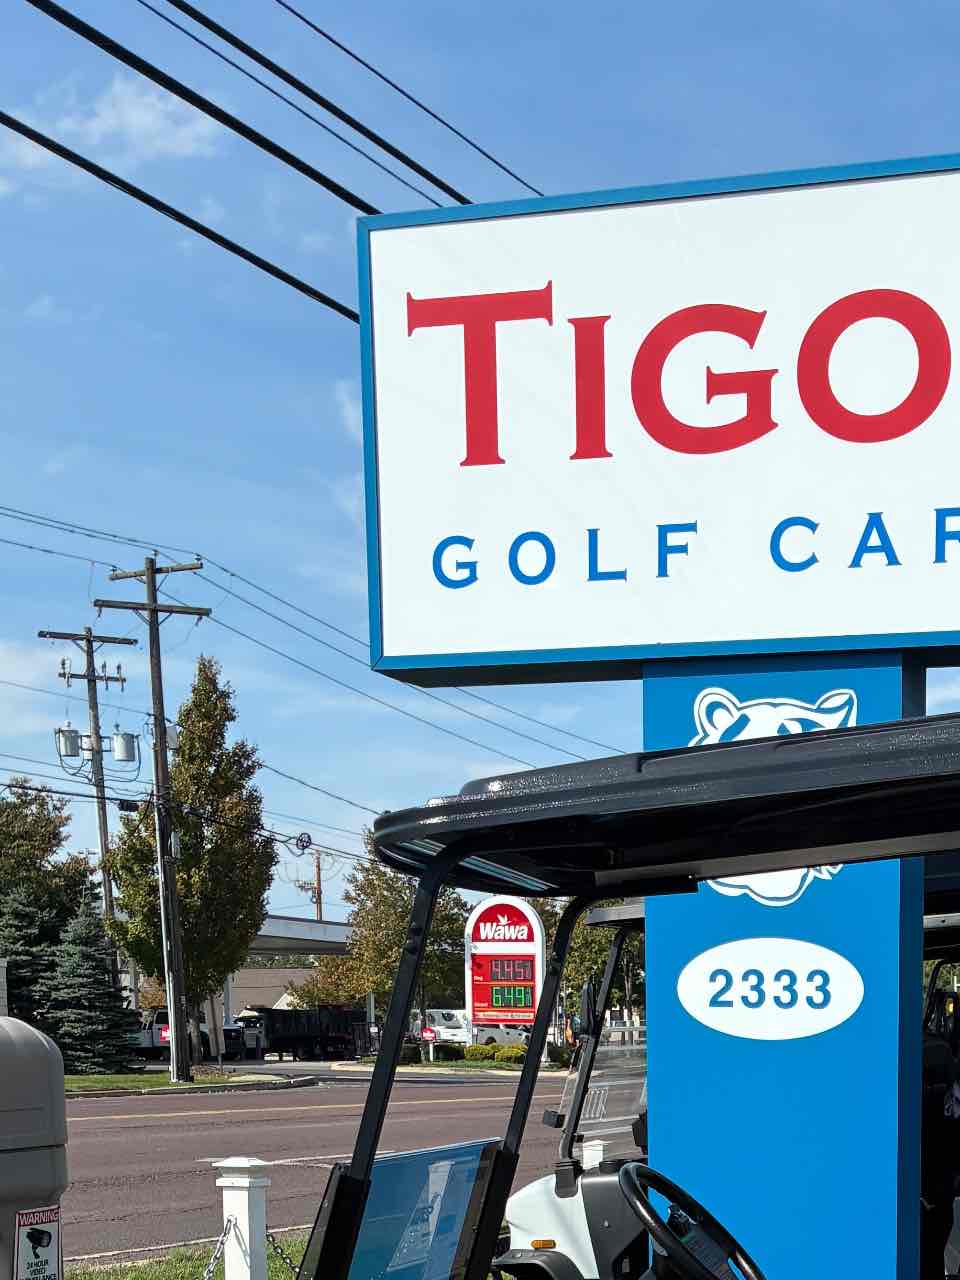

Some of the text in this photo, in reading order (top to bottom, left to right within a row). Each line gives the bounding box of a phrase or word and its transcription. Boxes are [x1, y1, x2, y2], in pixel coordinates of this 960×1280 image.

[431, 520, 698, 590] GOLF
[479, 922, 529, 940] Wawa
[708, 968, 832, 1010] 2333
[20, 1209, 58, 1225] WARNING
[29, 1267, 46, 1277] VIDEO
[34, 1259, 49, 1268] HOUR
